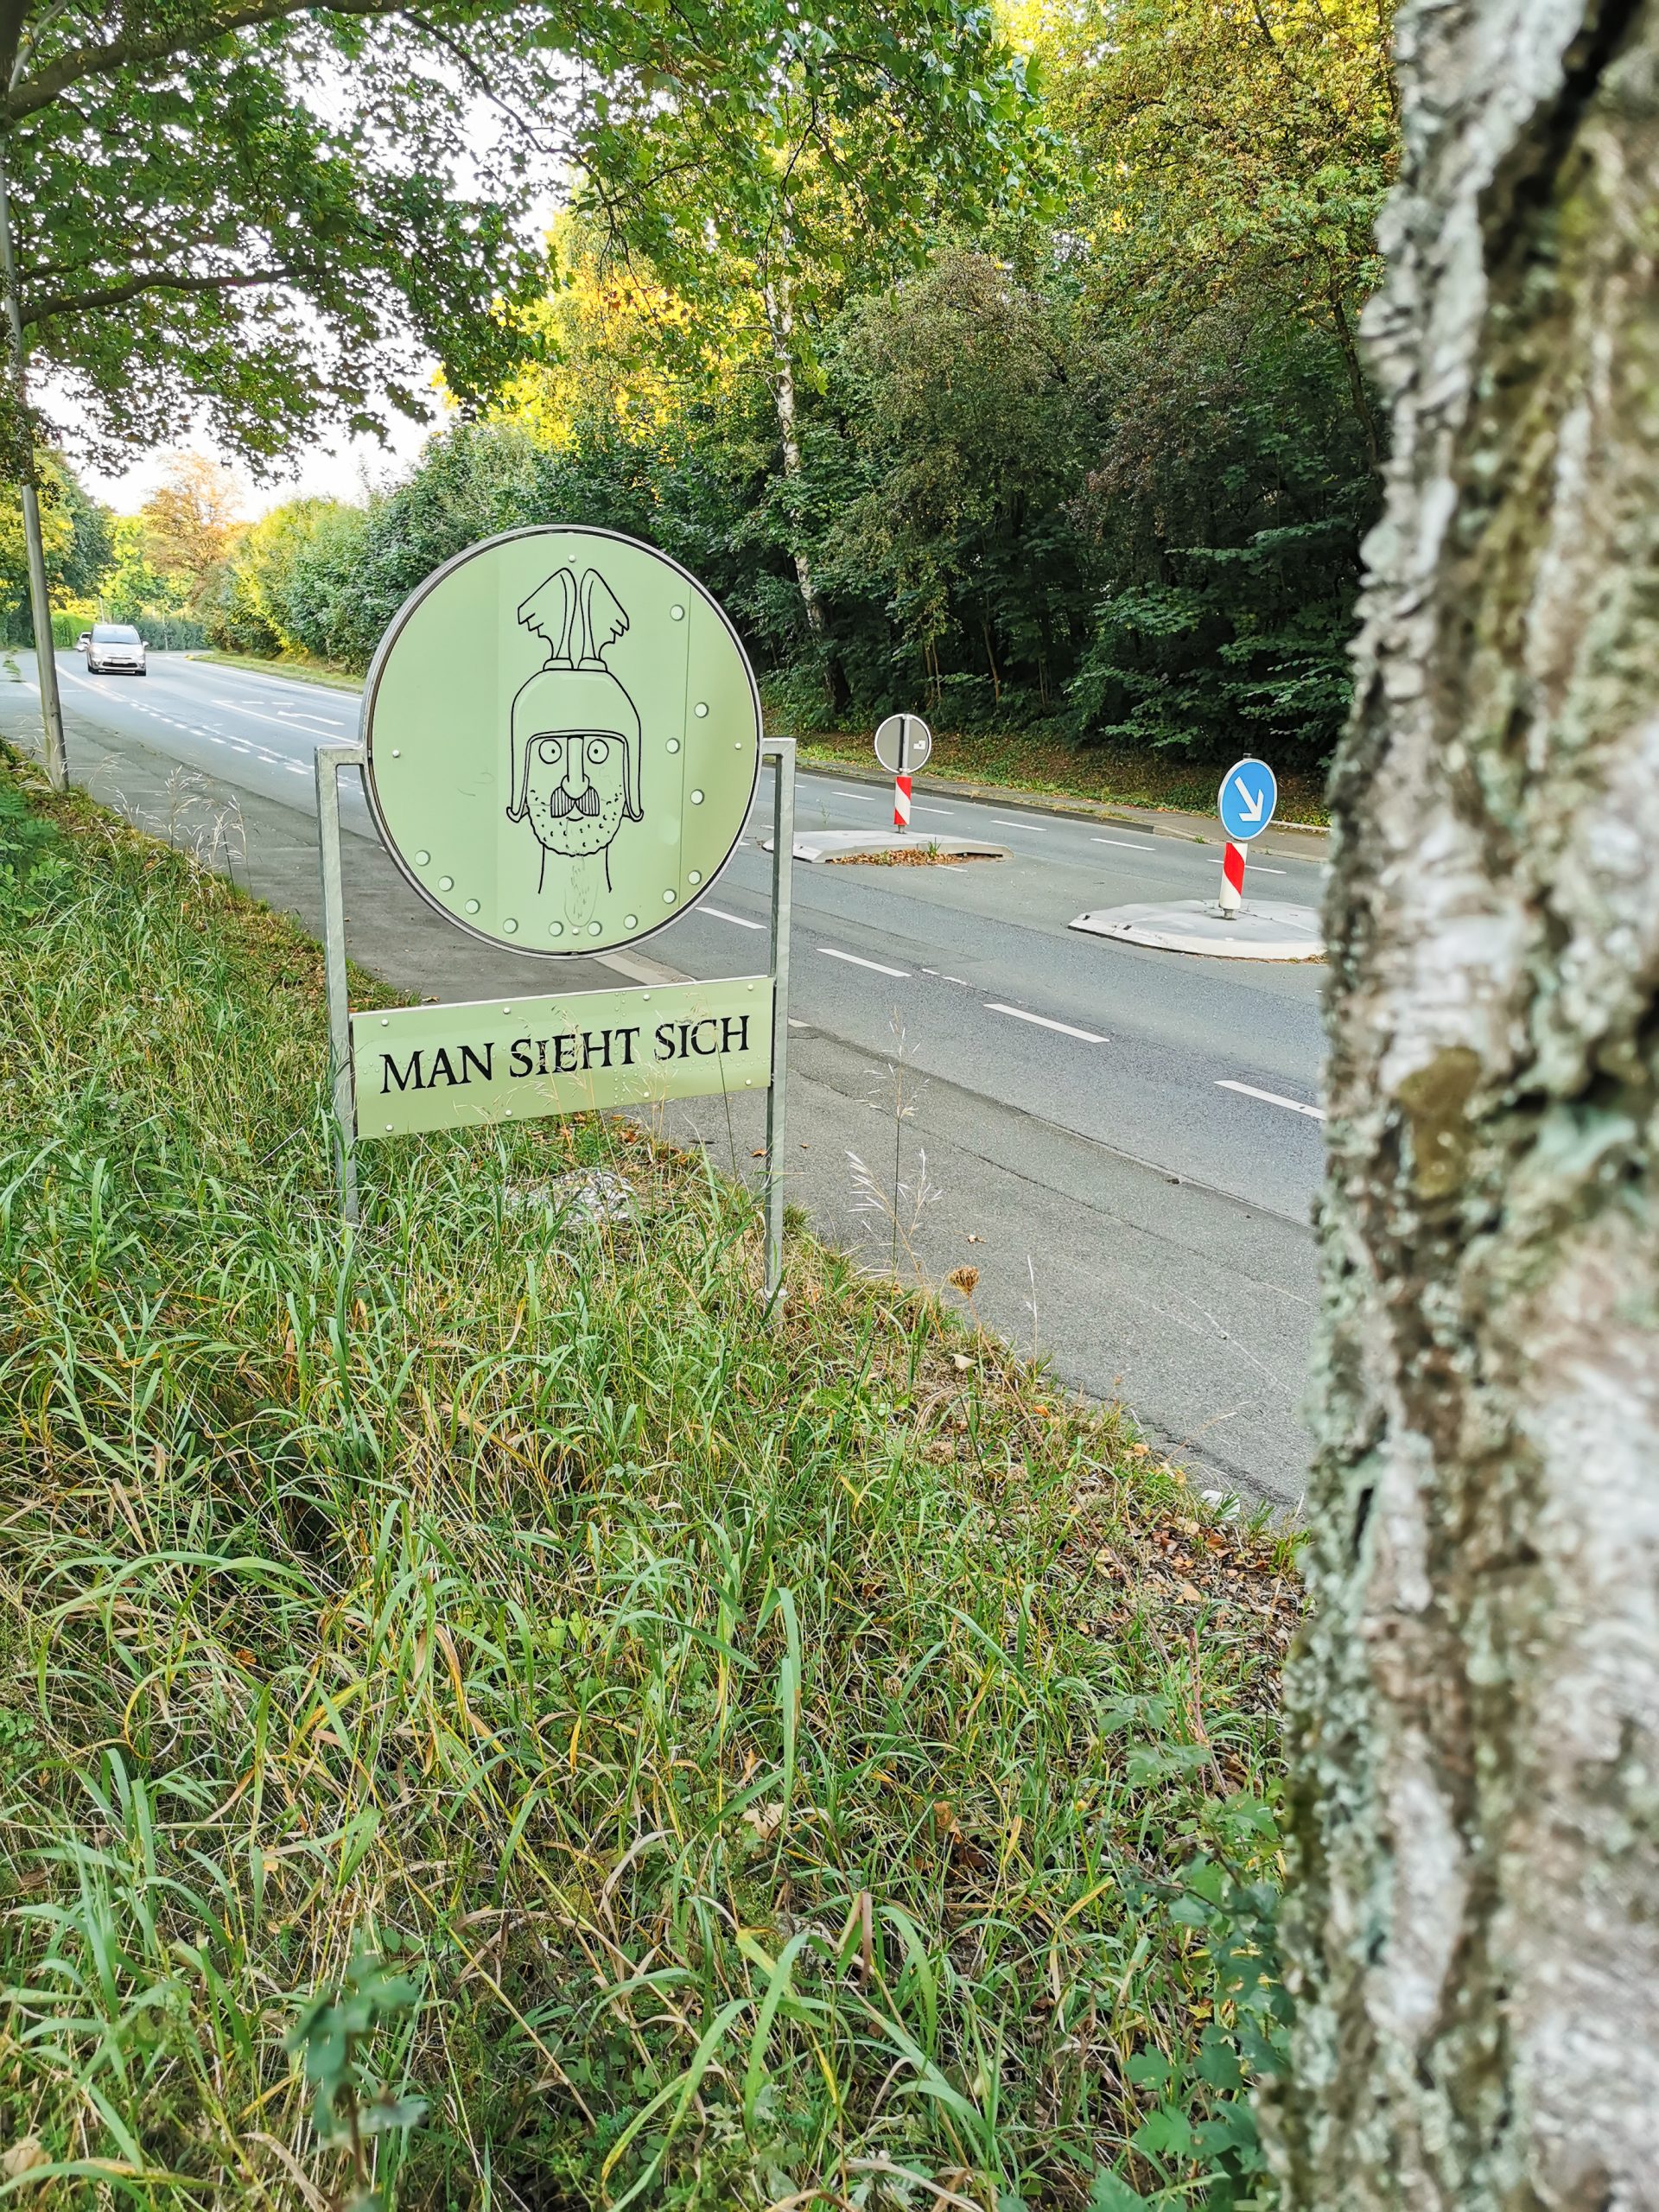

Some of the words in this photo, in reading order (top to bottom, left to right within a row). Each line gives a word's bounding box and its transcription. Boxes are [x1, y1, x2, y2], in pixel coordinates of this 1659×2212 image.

[380, 1042, 495, 1094] MAN
[509, 1027, 640, 1077] SIEHT
[653, 1014, 750, 1062] SICH
